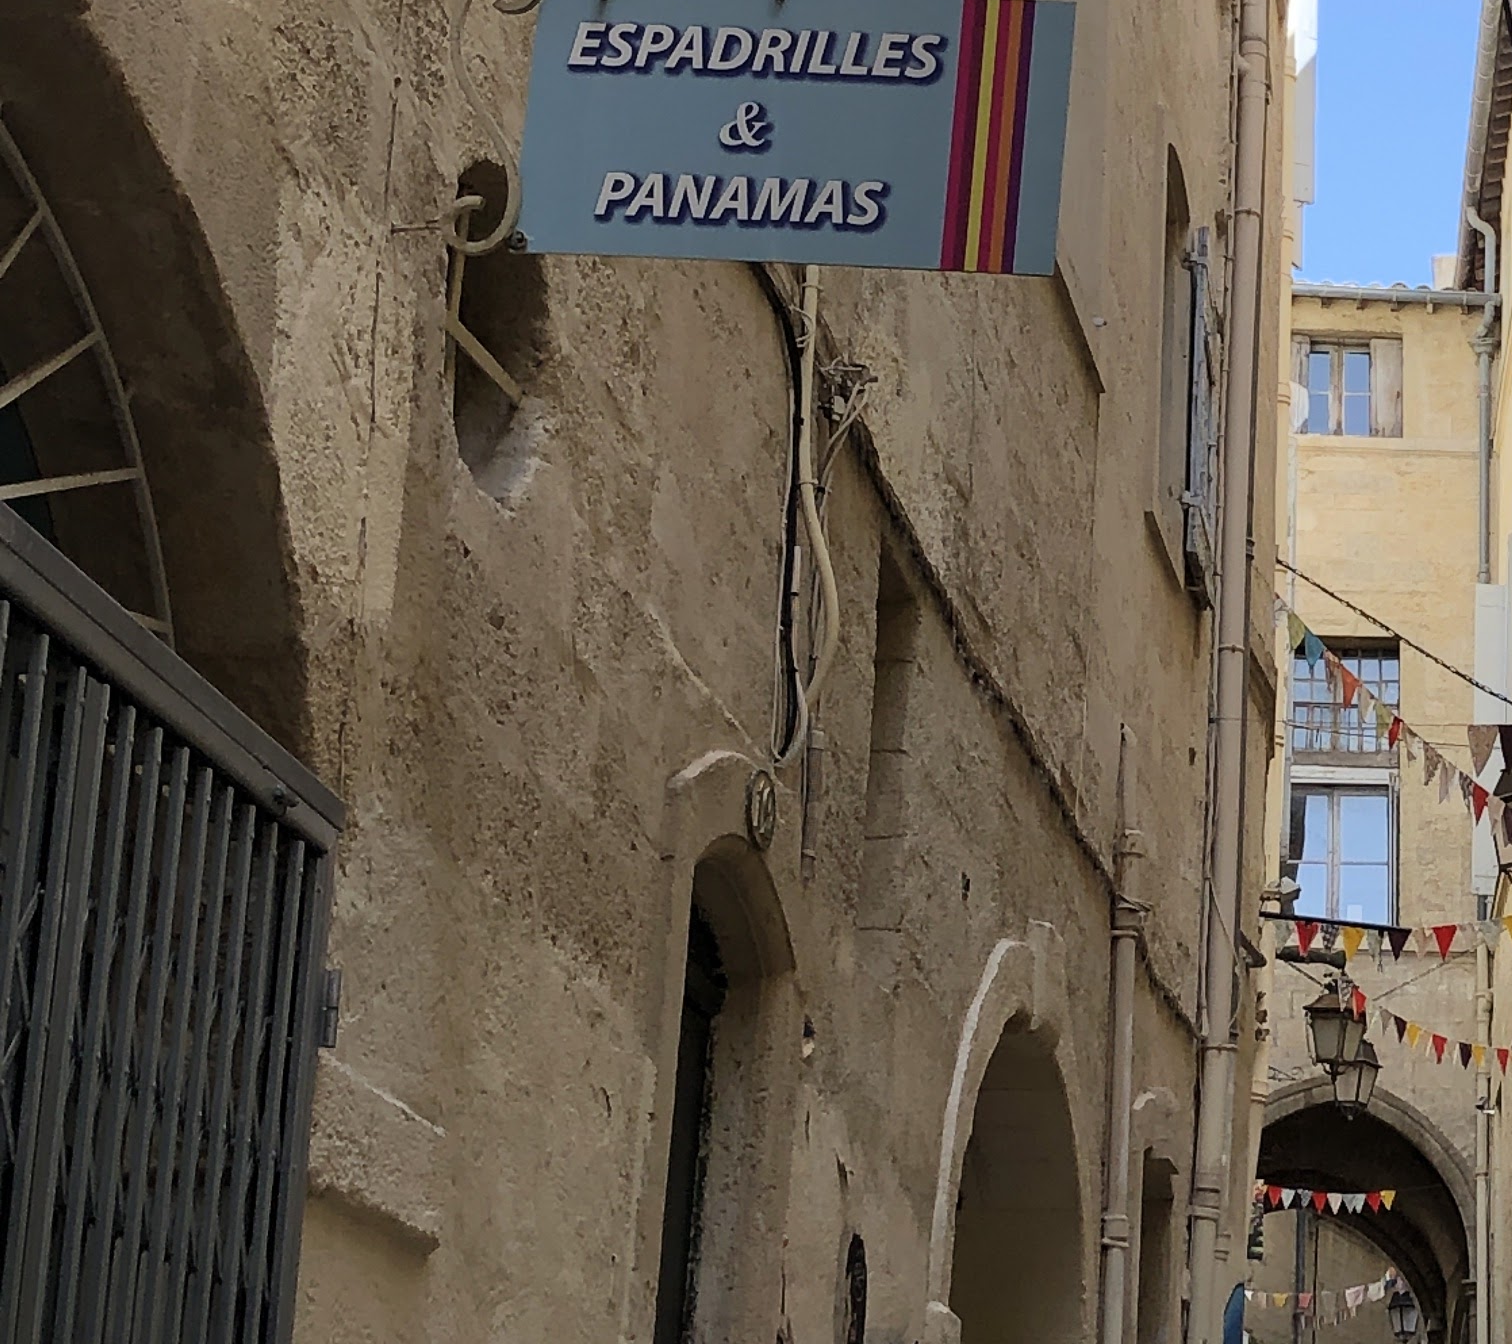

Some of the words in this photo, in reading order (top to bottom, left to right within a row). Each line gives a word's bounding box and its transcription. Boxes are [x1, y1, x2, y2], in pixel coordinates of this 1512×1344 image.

[567, 21, 944, 81] ESPADRILLES
[718, 101, 771, 148] &
[593, 171, 888, 229] PANAMAS
